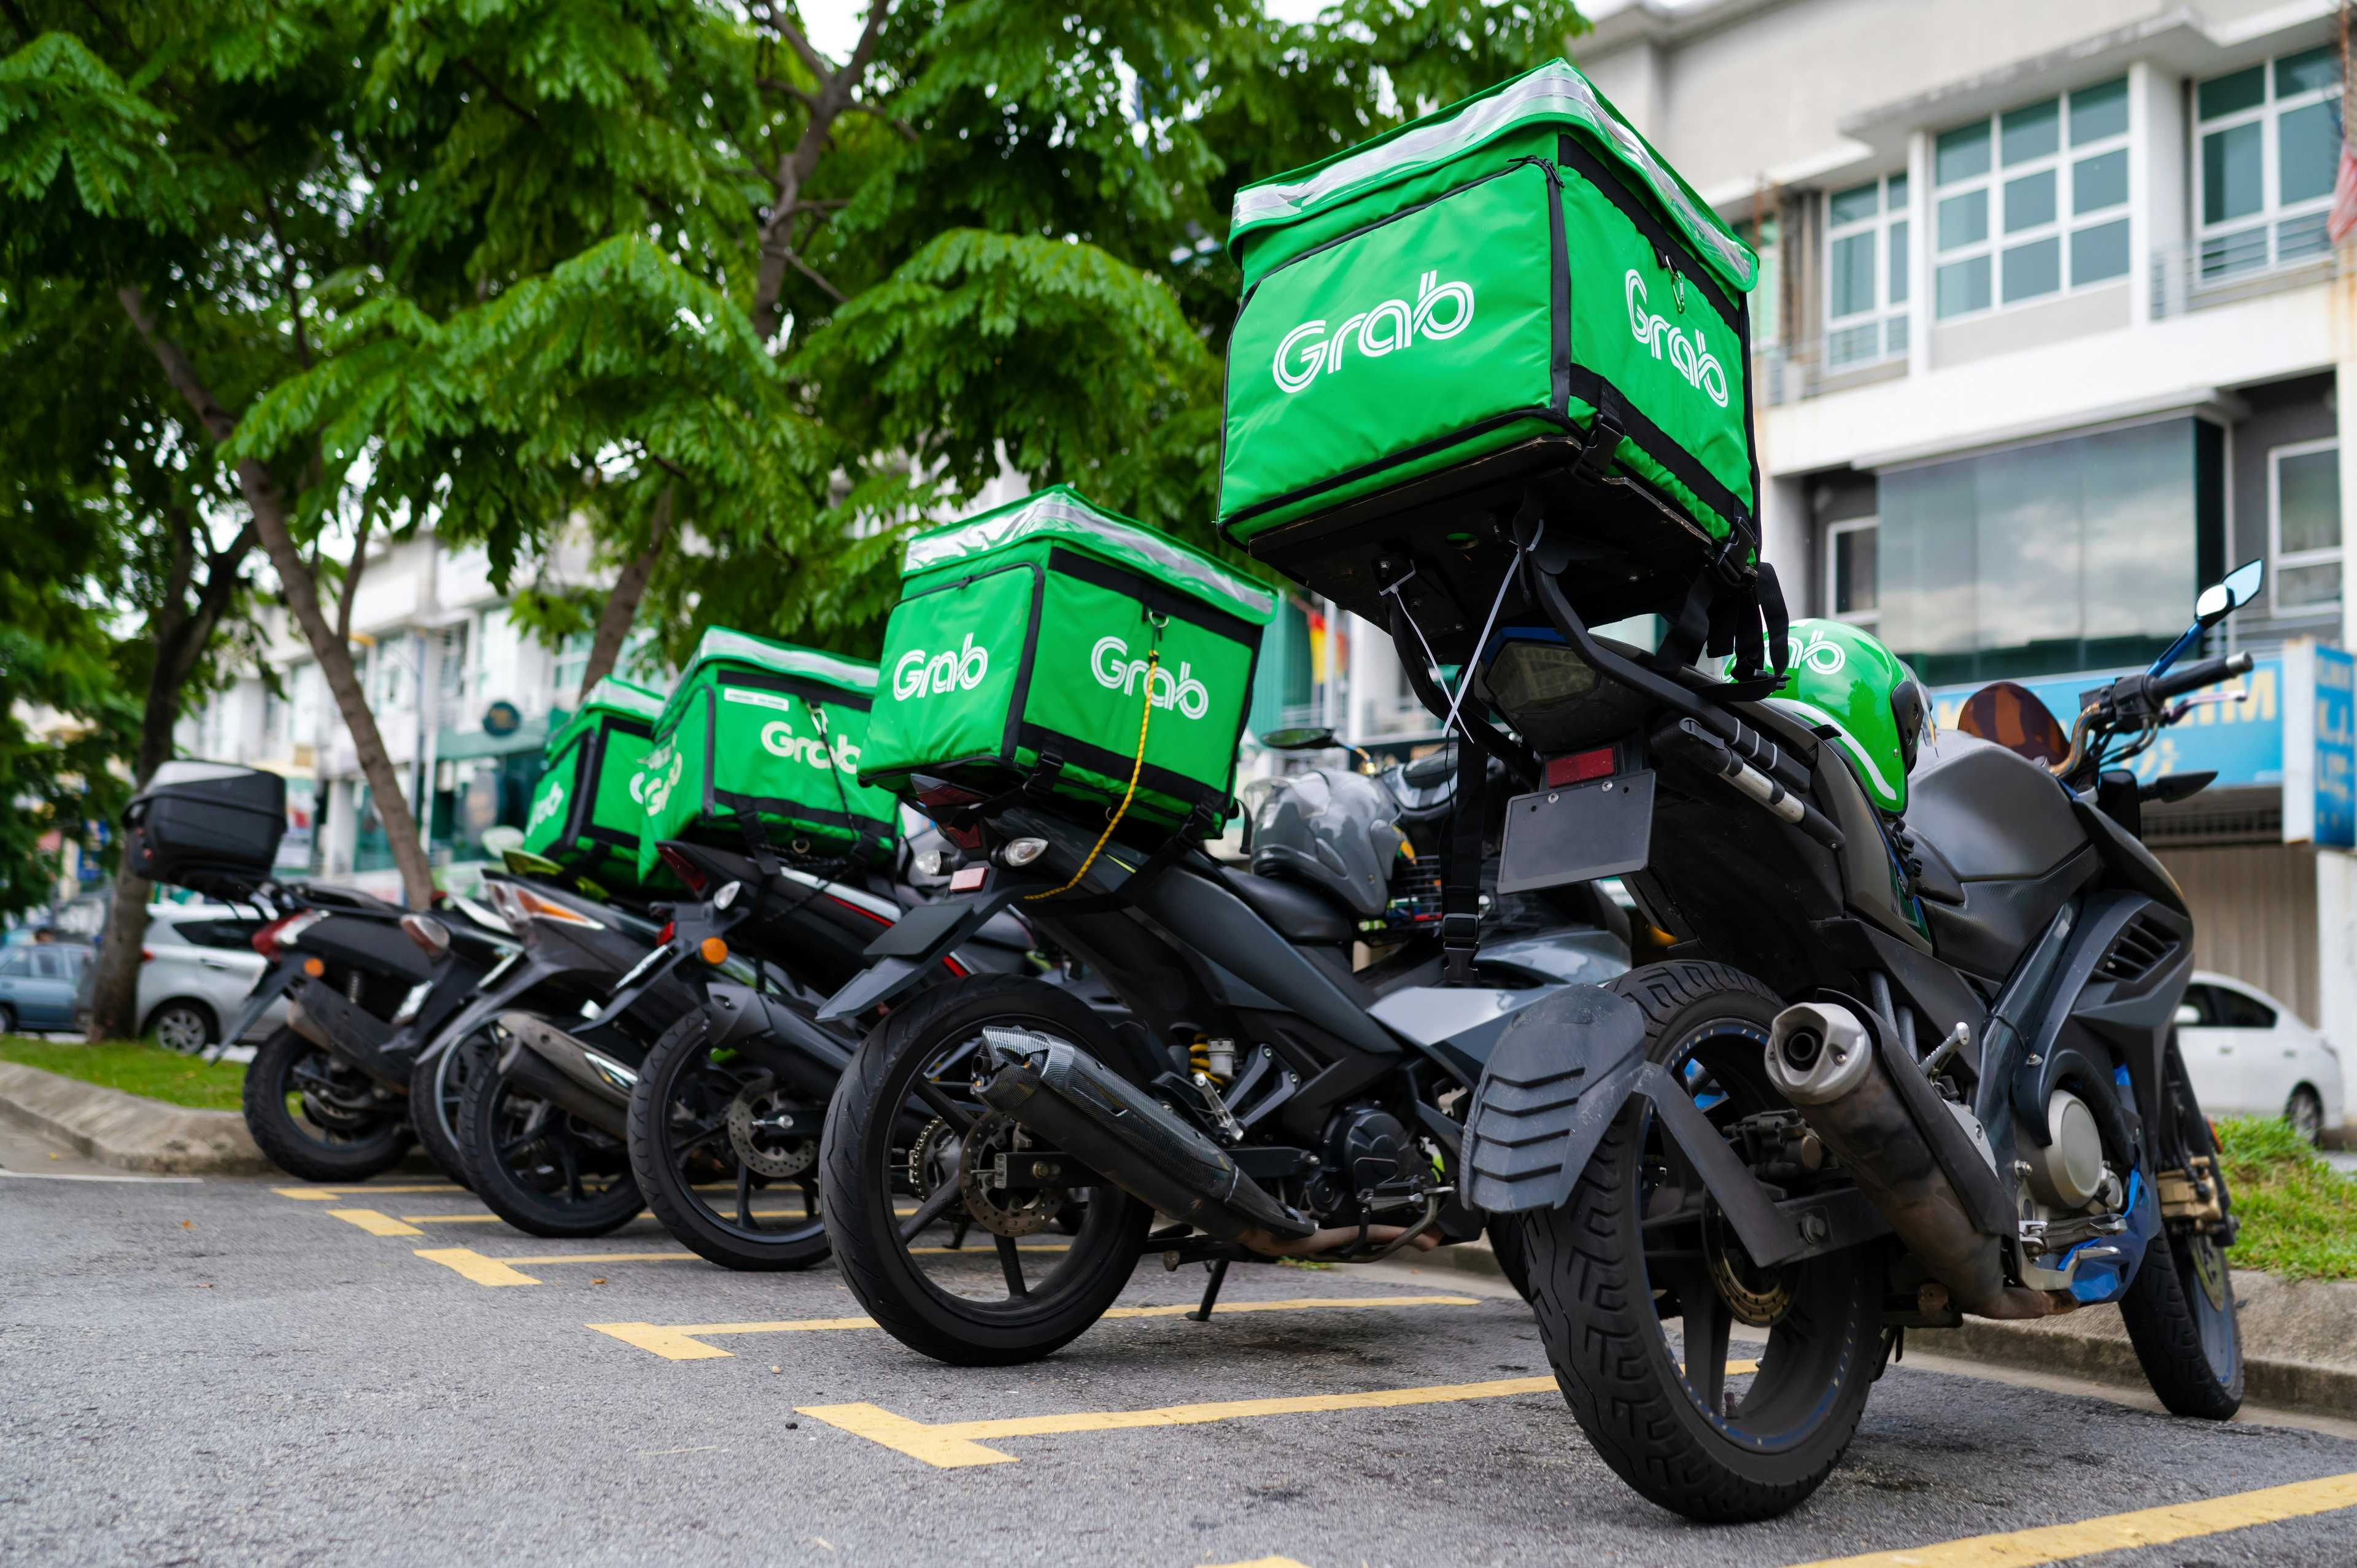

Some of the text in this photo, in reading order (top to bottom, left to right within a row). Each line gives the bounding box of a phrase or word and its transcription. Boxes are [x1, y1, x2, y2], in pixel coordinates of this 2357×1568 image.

[1272, 269, 1474, 393] Grab
[1625, 269, 1729, 408] Grab
[893, 633, 988, 701] Grab
[1091, 636, 1209, 720] Grab
[761, 720, 861, 774] Grab
